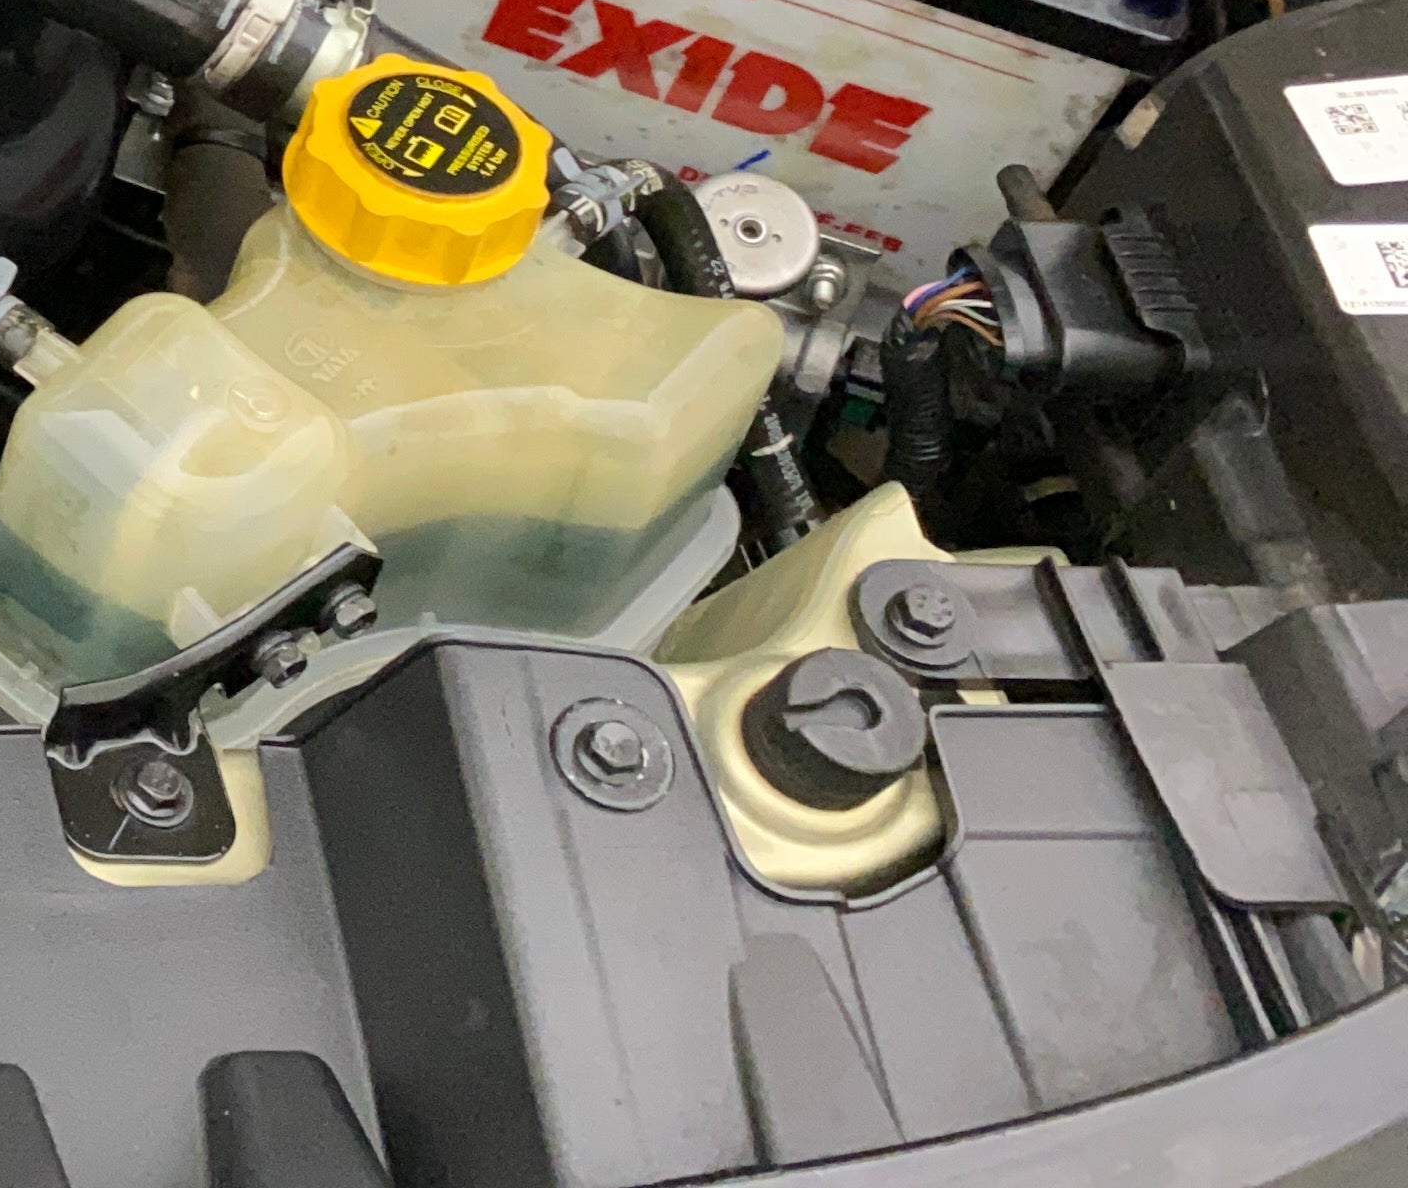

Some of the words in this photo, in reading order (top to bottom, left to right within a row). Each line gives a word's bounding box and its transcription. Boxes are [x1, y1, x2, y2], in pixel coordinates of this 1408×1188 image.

[366, 80, 404, 118] CAUTION
[415, 75, 464, 96] CLOSE
[384, 126, 409, 151] NEVER
[402, 106, 425, 129] OPEN
[418, 91, 435, 112] HOT
[362, 142, 395, 170] OPEN
[465, 140, 495, 172] SYSTEM
[493, 147, 509, 166] bar
